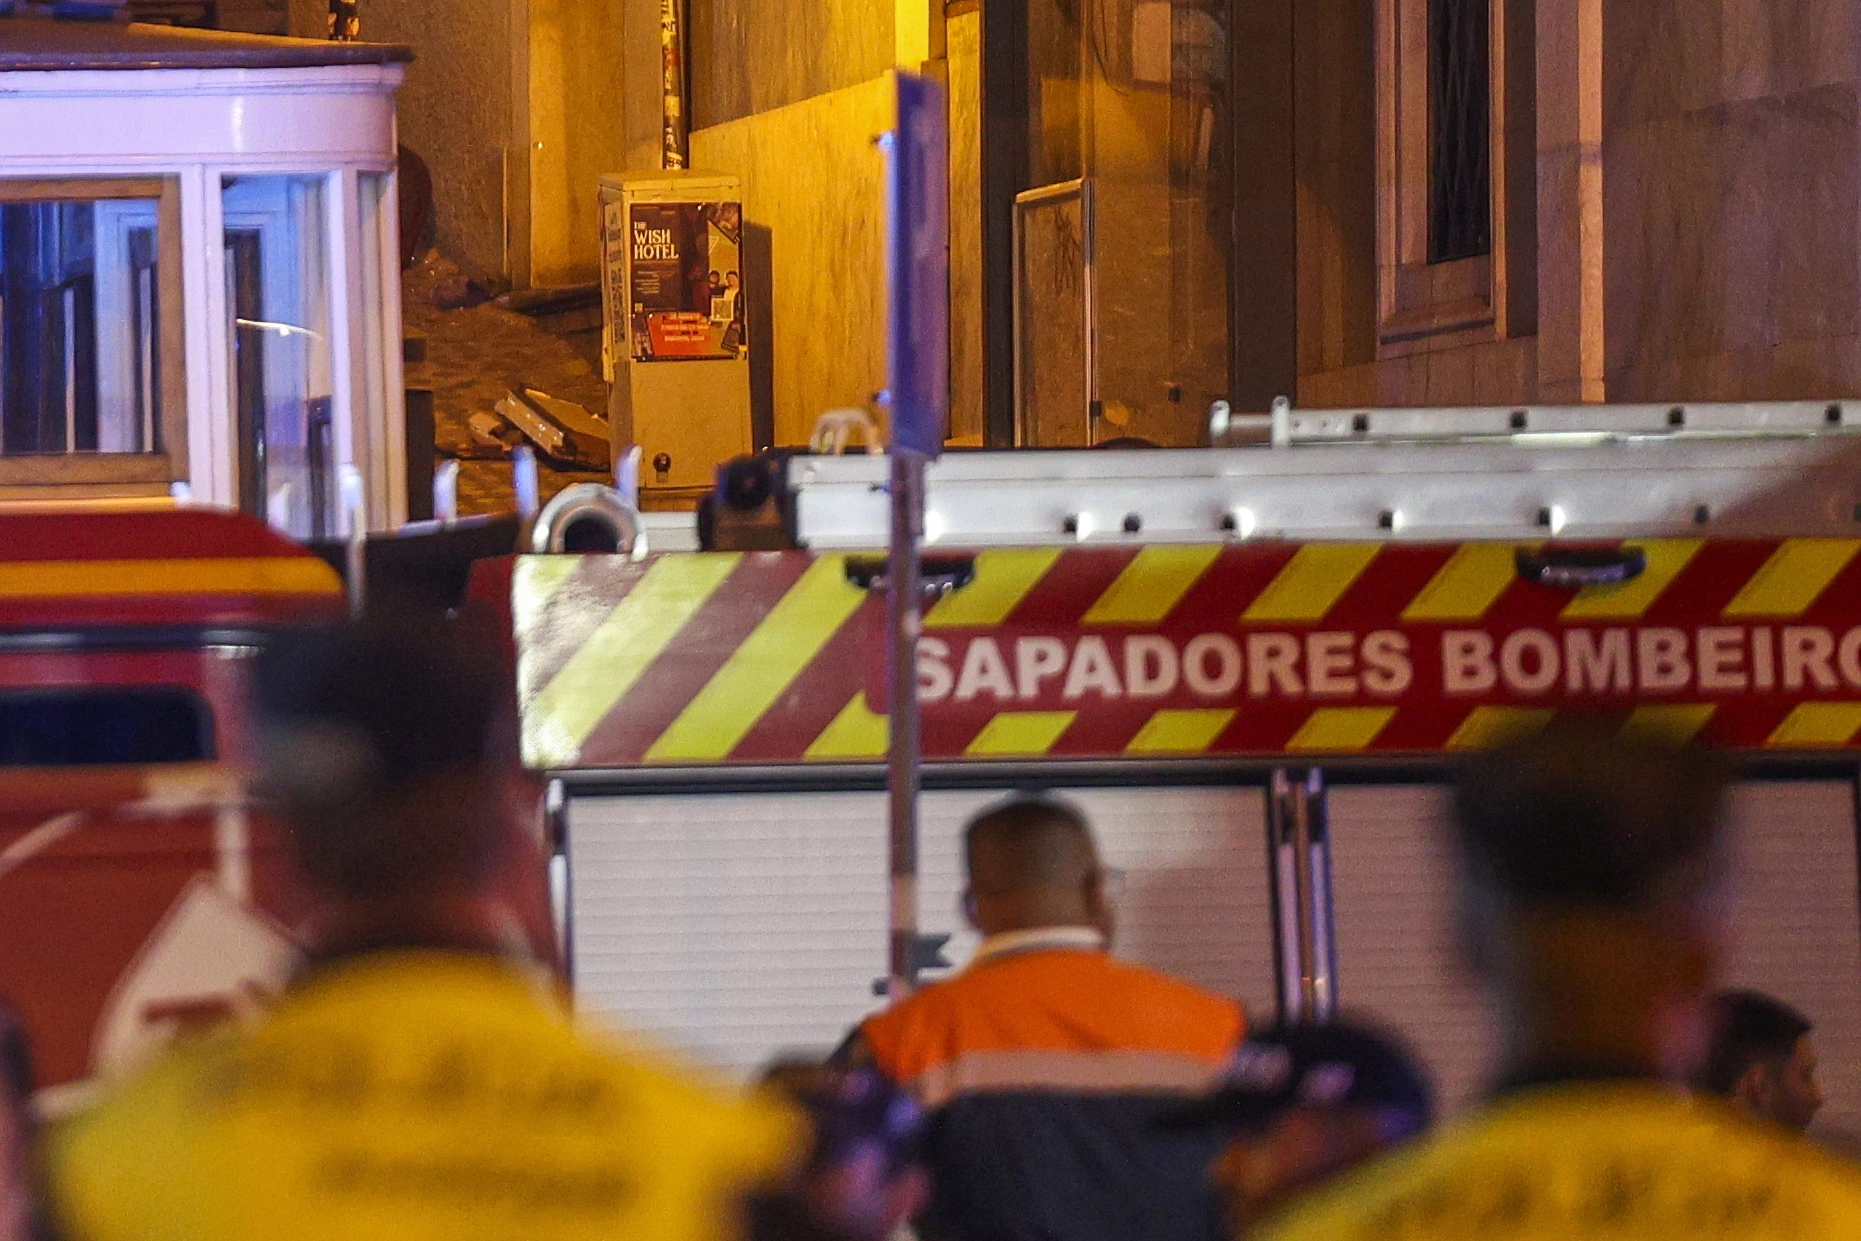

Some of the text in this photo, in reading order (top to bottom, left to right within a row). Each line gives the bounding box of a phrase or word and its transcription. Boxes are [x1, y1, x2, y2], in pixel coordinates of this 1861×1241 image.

[634, 229, 671, 244] WISH
[634, 244, 679, 260] HOTEL
[914, 628, 1412, 700] SAPADORES
